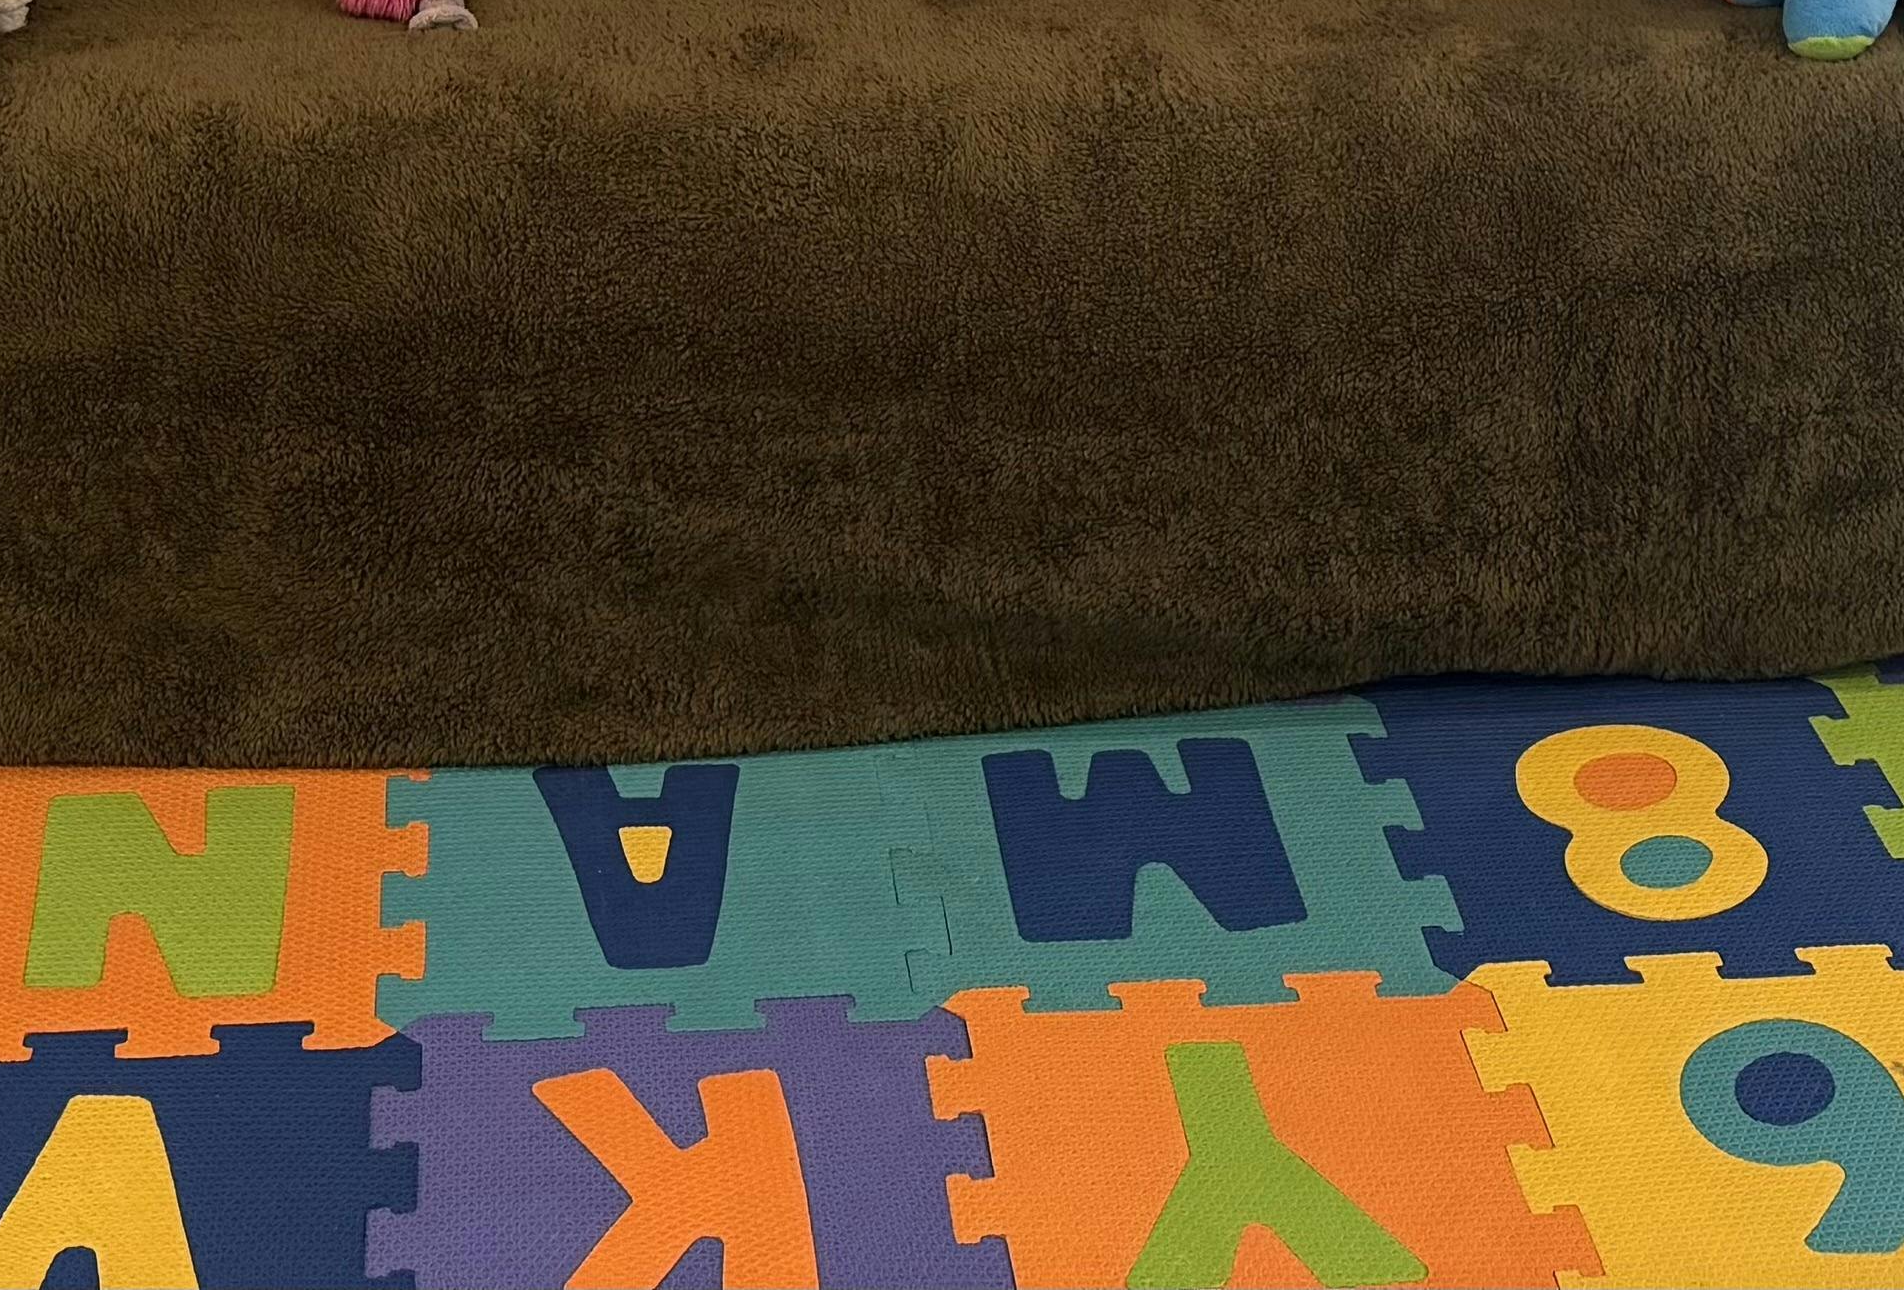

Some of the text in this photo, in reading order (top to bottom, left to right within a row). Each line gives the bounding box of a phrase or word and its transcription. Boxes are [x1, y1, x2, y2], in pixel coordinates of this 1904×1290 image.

[23, 784, 295, 995] N
[533, 763, 741, 968] A
[1515, 723, 1769, 922] 8
[531, 1067, 820, 1290] K
